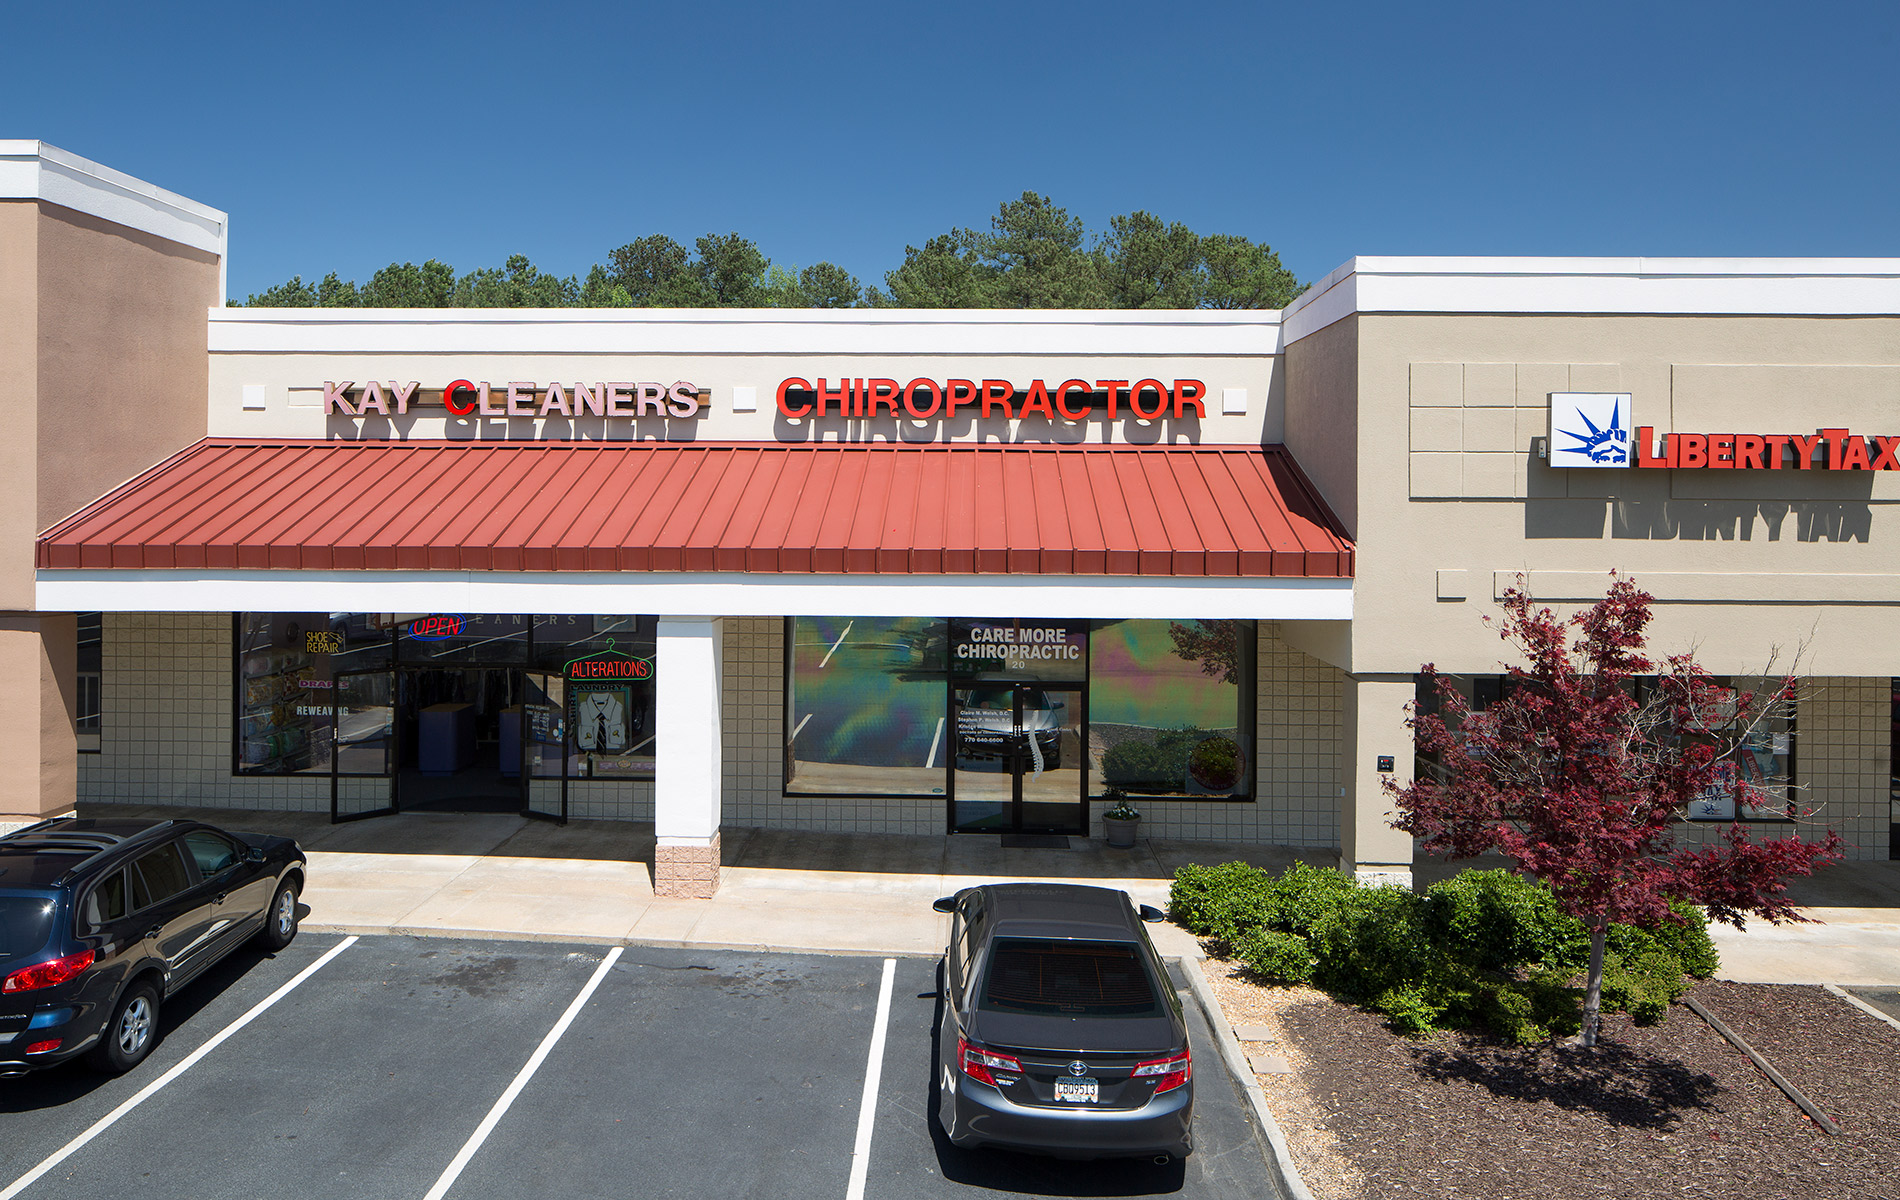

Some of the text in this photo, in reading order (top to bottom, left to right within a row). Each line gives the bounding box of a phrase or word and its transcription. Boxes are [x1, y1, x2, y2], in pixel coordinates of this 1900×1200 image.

[323, 378, 701, 418] KAY CLEANERS
[775, 377, 1207, 420] CHIROPRACTOR
[1818, 428, 1900, 470] TAX
[413, 617, 460, 635] OPEN
[475, 614, 576, 625] EANERS
[306, 631, 328, 643] SHOE
[970, 627, 1066, 643] CARE MORE
[306, 642, 340, 653] REPAIR
[957, 643, 1080, 660] CHIROPRACTIC
[571, 661, 648, 677] ALTERATIONS
[1011, 661, 1025, 669] 20
[296, 705, 349, 716] REWEAVNG
[569, 694, 577, 725] SHIRT
